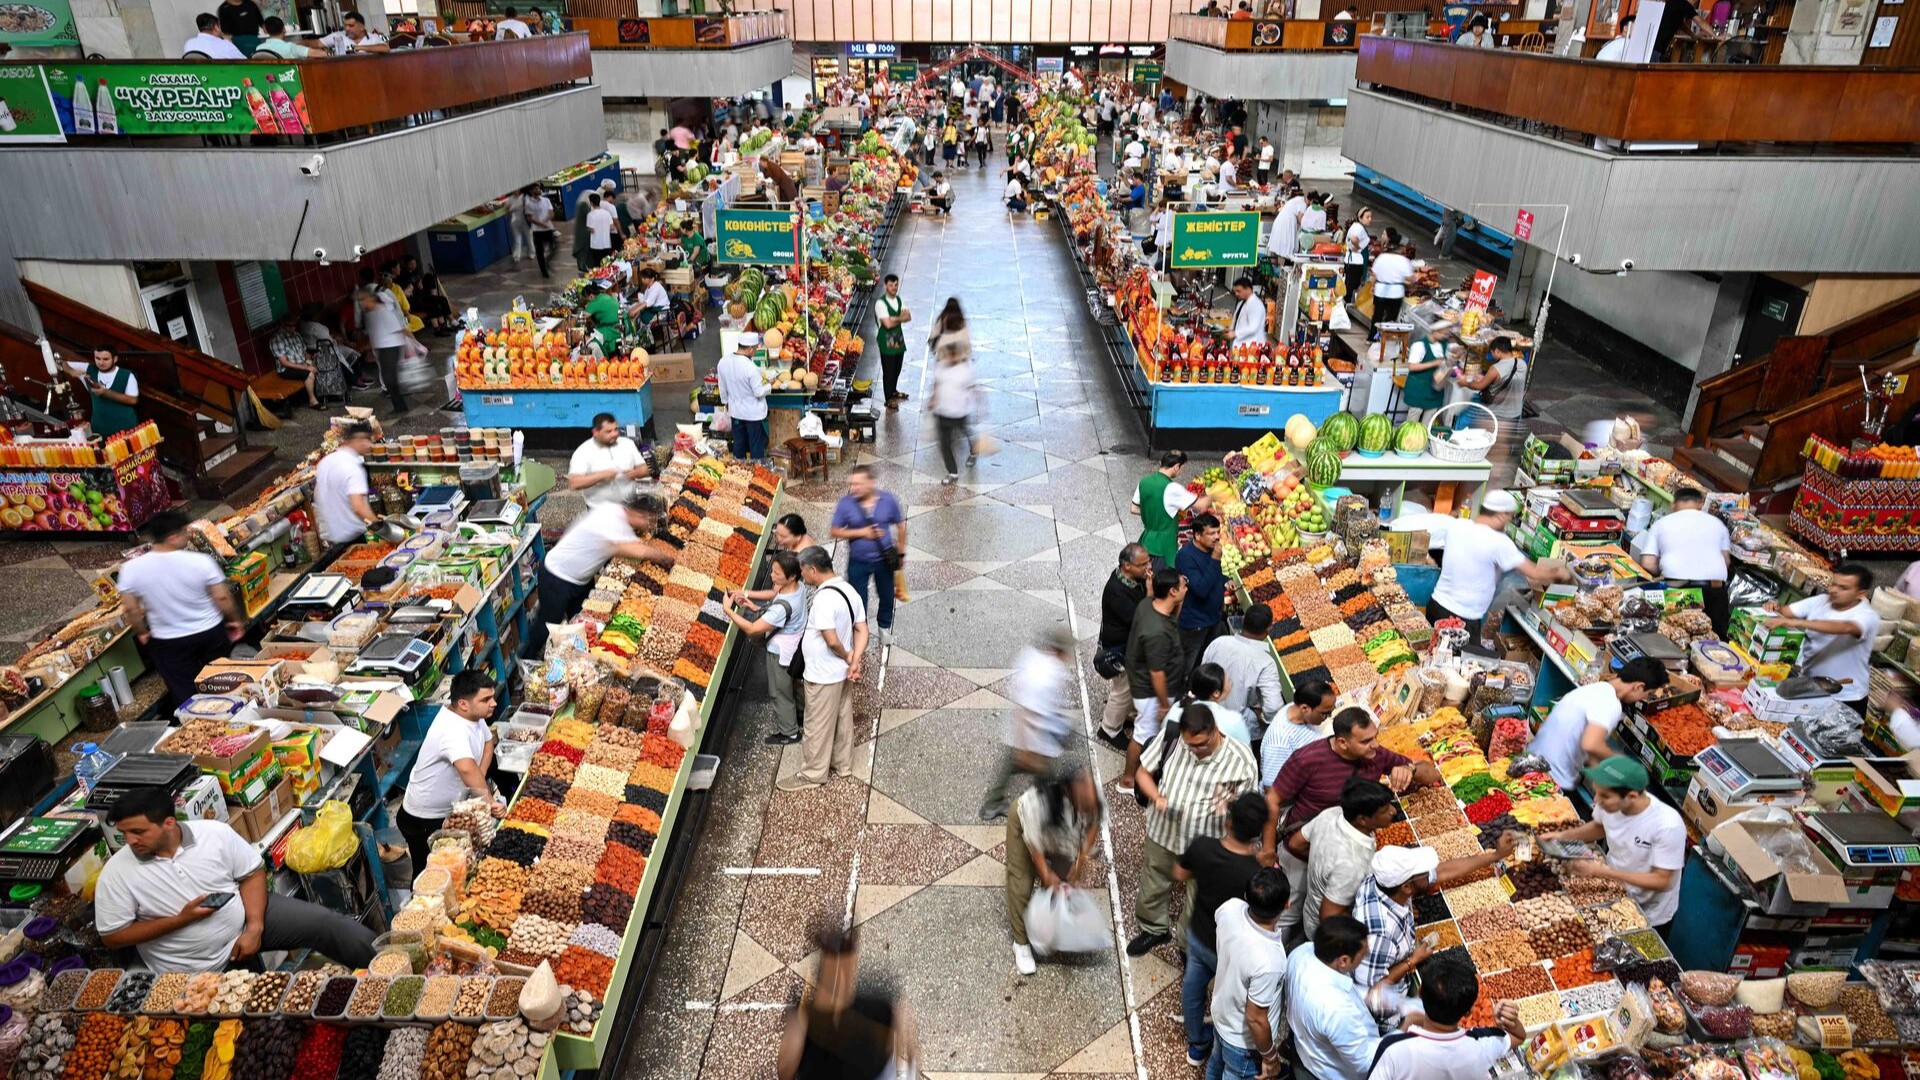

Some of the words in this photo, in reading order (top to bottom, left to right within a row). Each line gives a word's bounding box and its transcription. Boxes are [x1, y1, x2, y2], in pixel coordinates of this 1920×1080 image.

[851, 44, 865, 53] DELI
[879, 44, 896, 53] FOOD
[149, 74, 201, 85] АСХАНА
[145, 111, 225, 121] ЗАКУСОЧНАЯ
[725, 219, 794, 232] КӨКӨНІСТЕР
[1186, 221, 1246, 233] ЖЕМІСТЕР
[116, 451, 156, 475] ГРАНАТОВЫЙ
[53, 474, 81, 483] СОК
[119, 471, 137, 486] СОК
[3, 486, 48, 496] ГРАНАТ
[193, 787, 215, 815] Орехи
